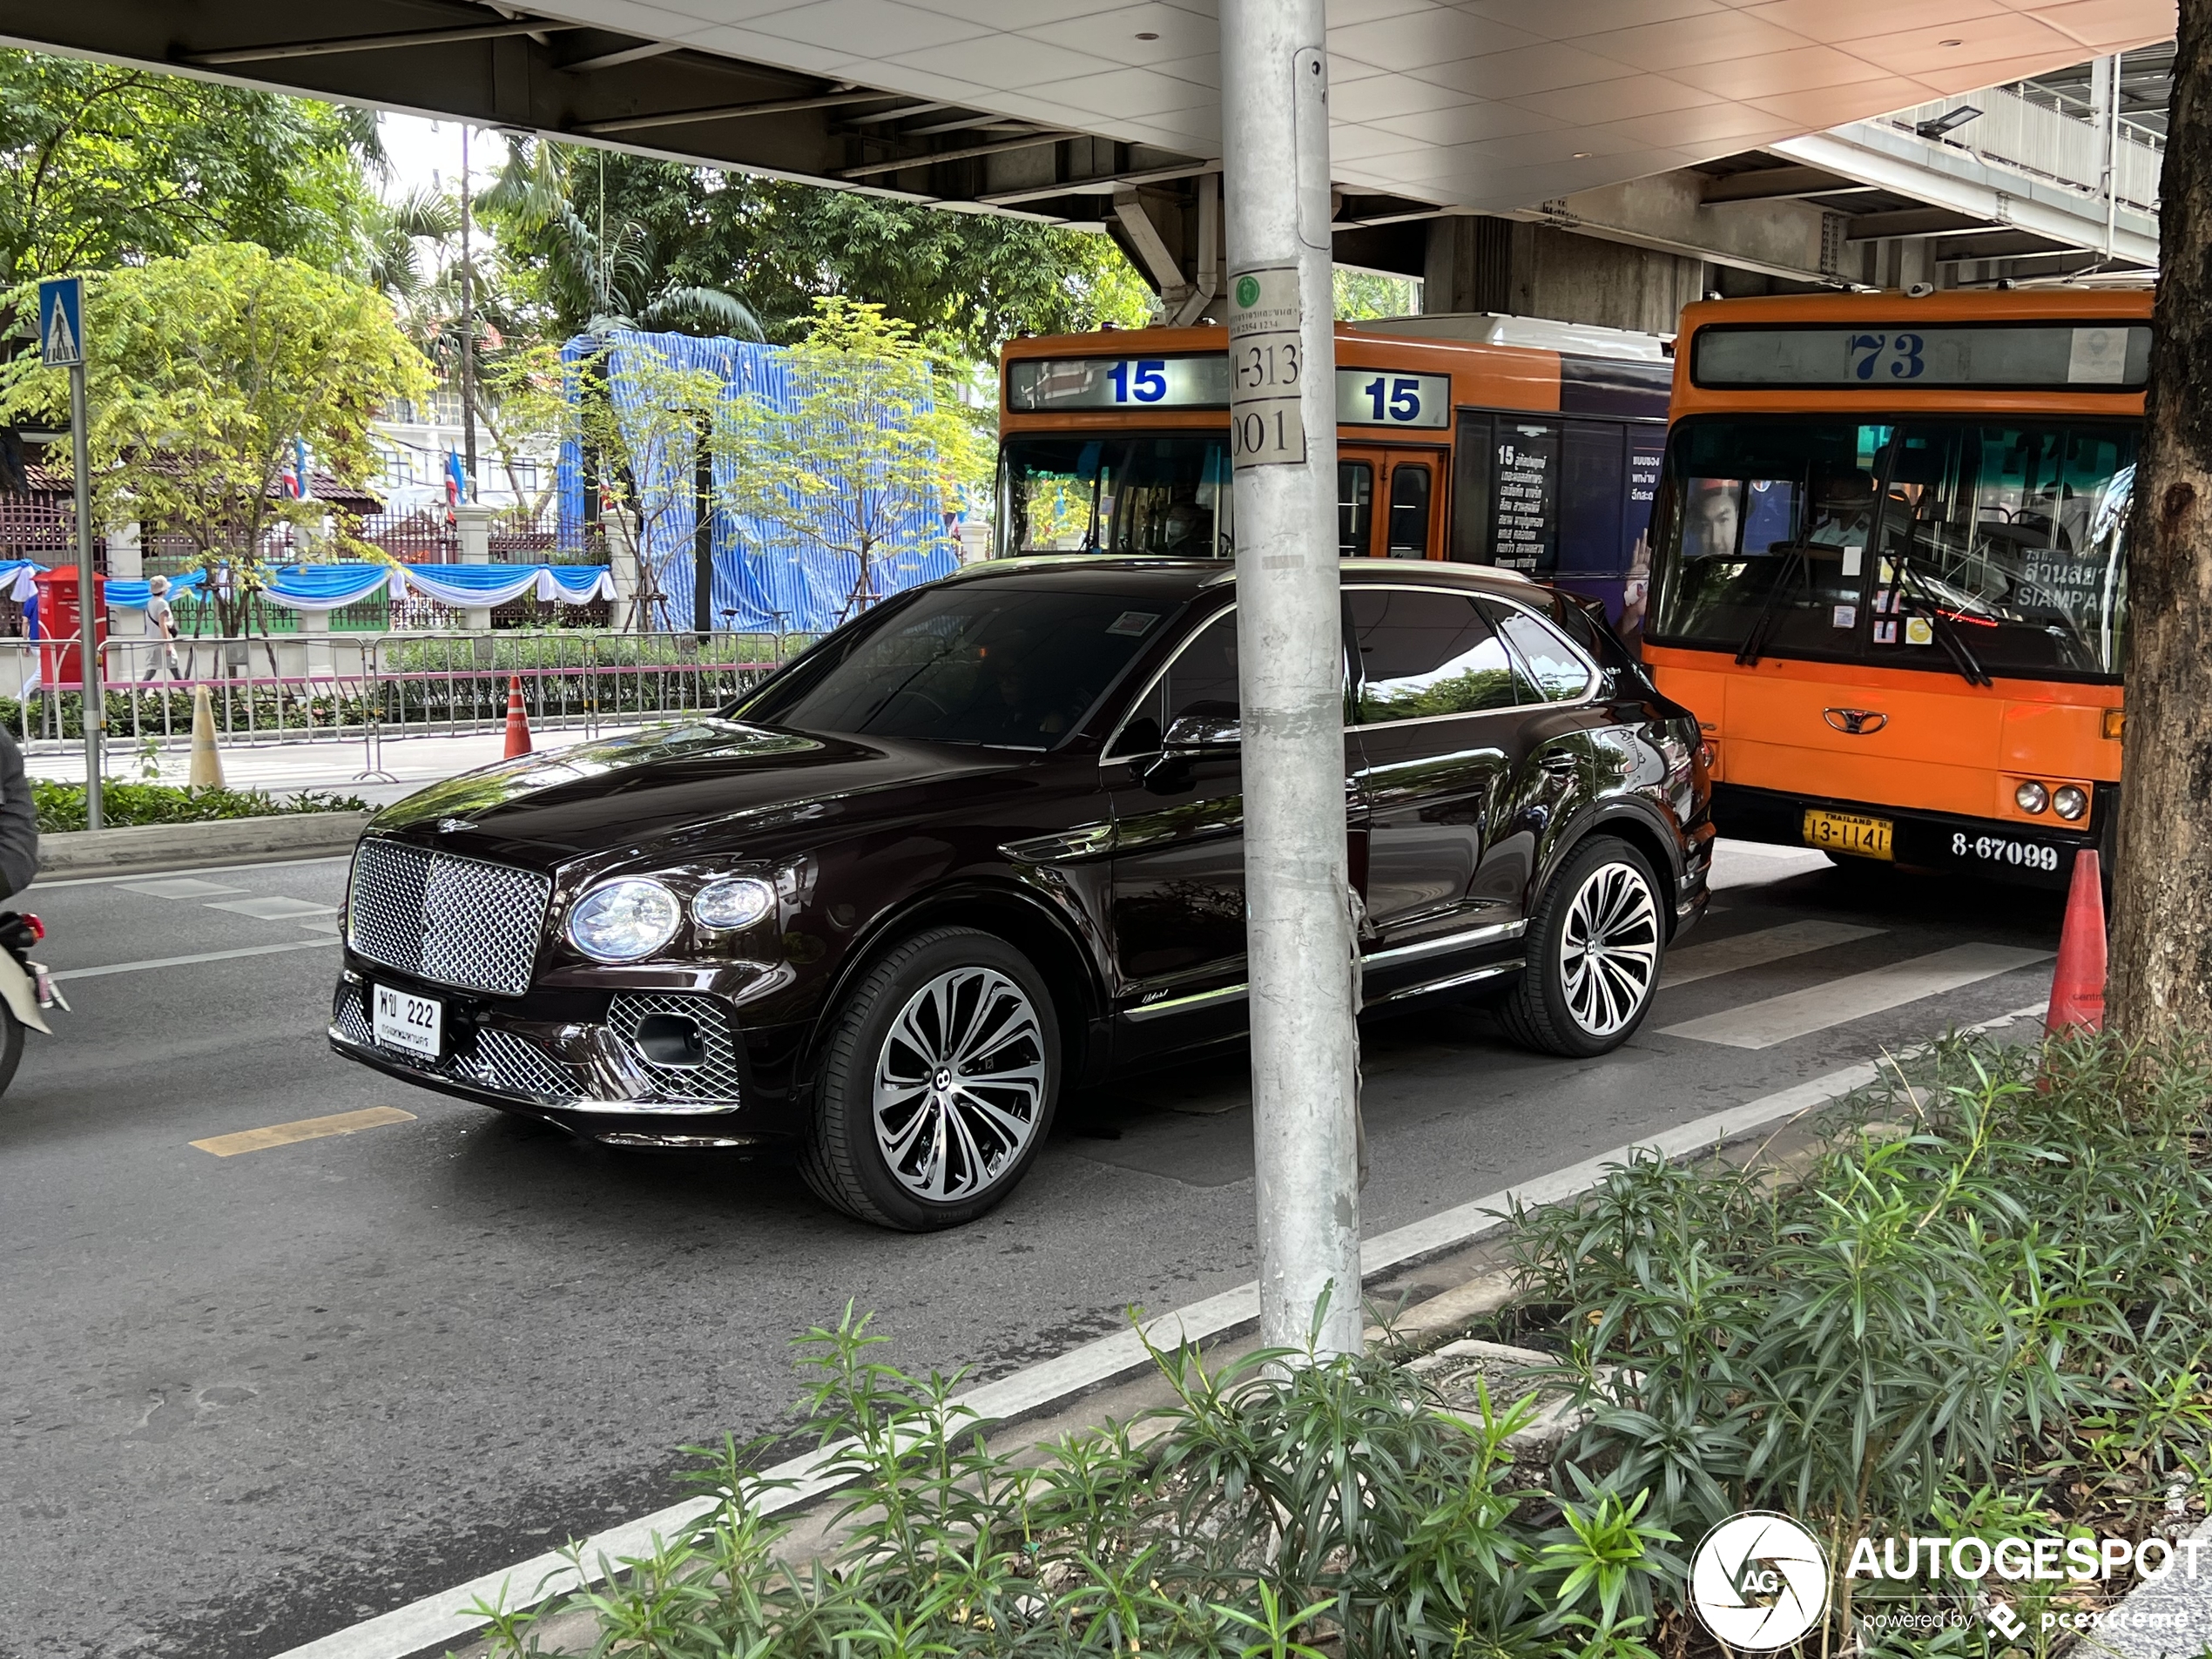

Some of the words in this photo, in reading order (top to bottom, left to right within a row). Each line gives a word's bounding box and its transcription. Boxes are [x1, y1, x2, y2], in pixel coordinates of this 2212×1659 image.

[1260, 320, 1278, 329] 1234
[1851, 334, 1925, 380] 73
[1107, 361, 1167, 403] 15
[1365, 377, 1421, 421] 15
[1498, 445, 1514, 465] 15
[1811, 819, 1884, 850] 13-1141
[1824, 813, 1872, 826] THAILAND
[1952, 833, 2058, 872] 8-67099
[408, 999, 433, 1028] 222
